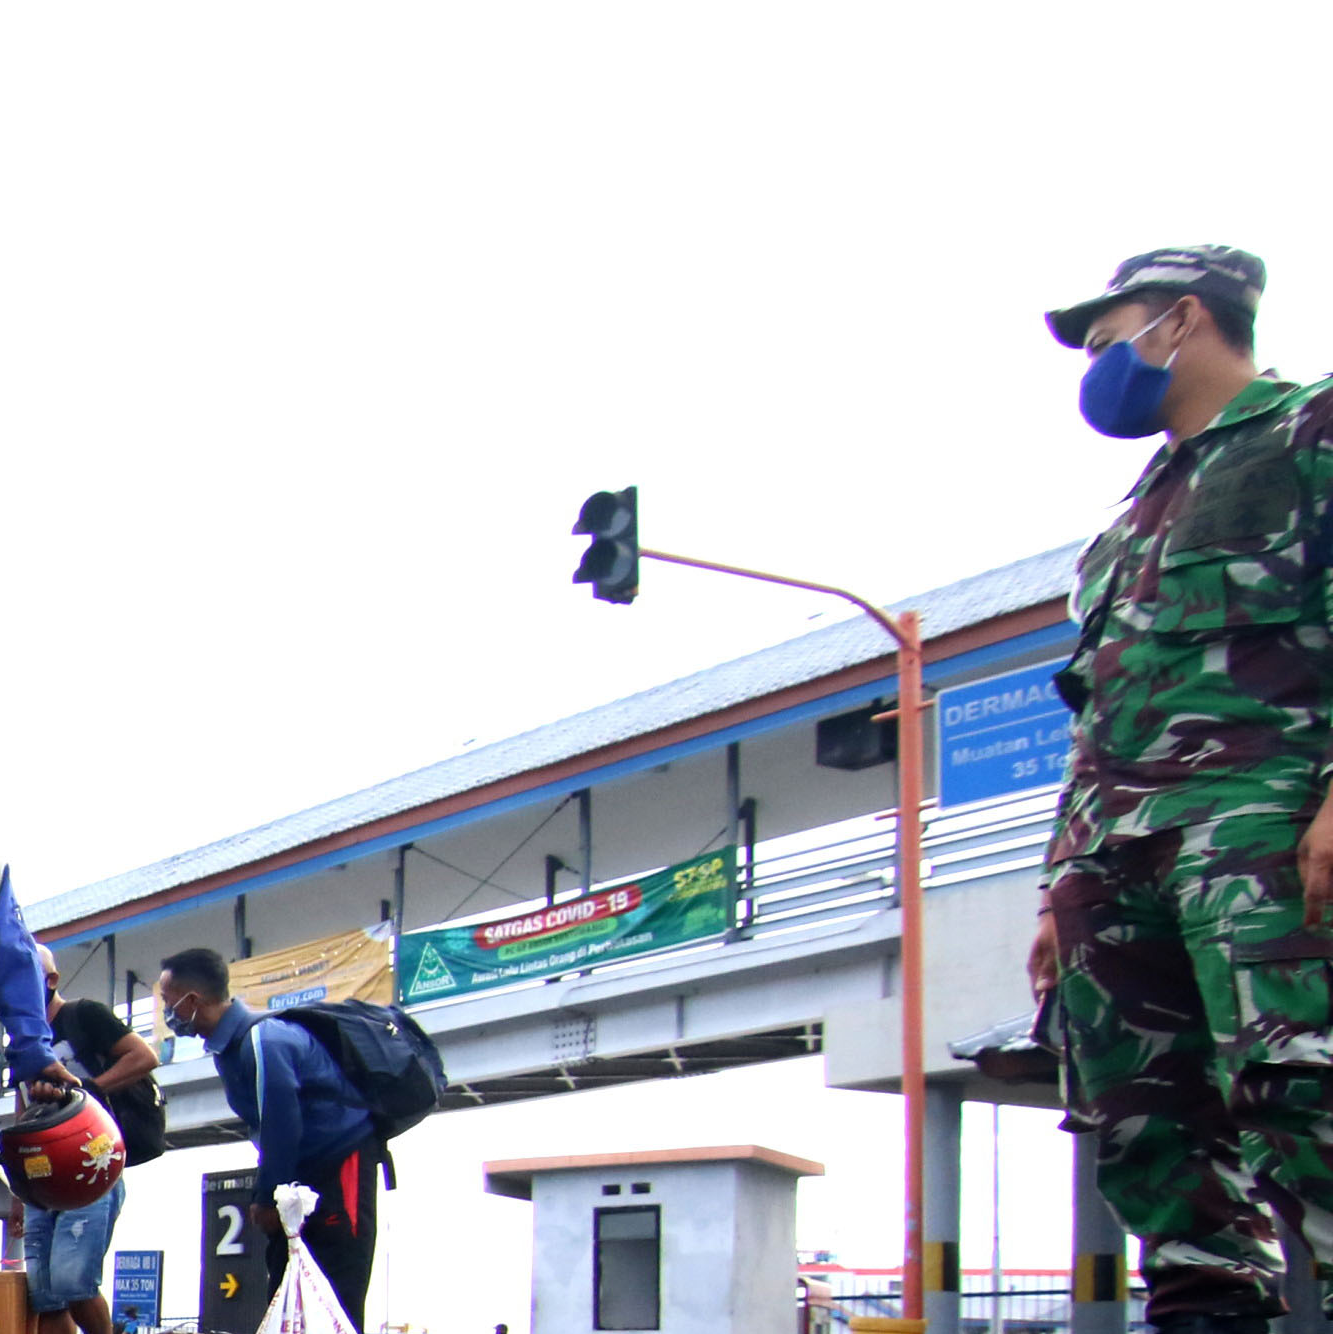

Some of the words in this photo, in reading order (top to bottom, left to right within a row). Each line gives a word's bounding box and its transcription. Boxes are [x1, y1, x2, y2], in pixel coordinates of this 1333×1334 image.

[1012, 758, 1040, 779] 35
[484, 914, 543, 944] SATGAS
[520, 960, 549, 975] Lintas
[549, 952, 577, 968] Orang
[203, 1175, 255, 1192] Dermag
[215, 1204, 245, 1256] 2
[116, 1279, 131, 1291] MAX
